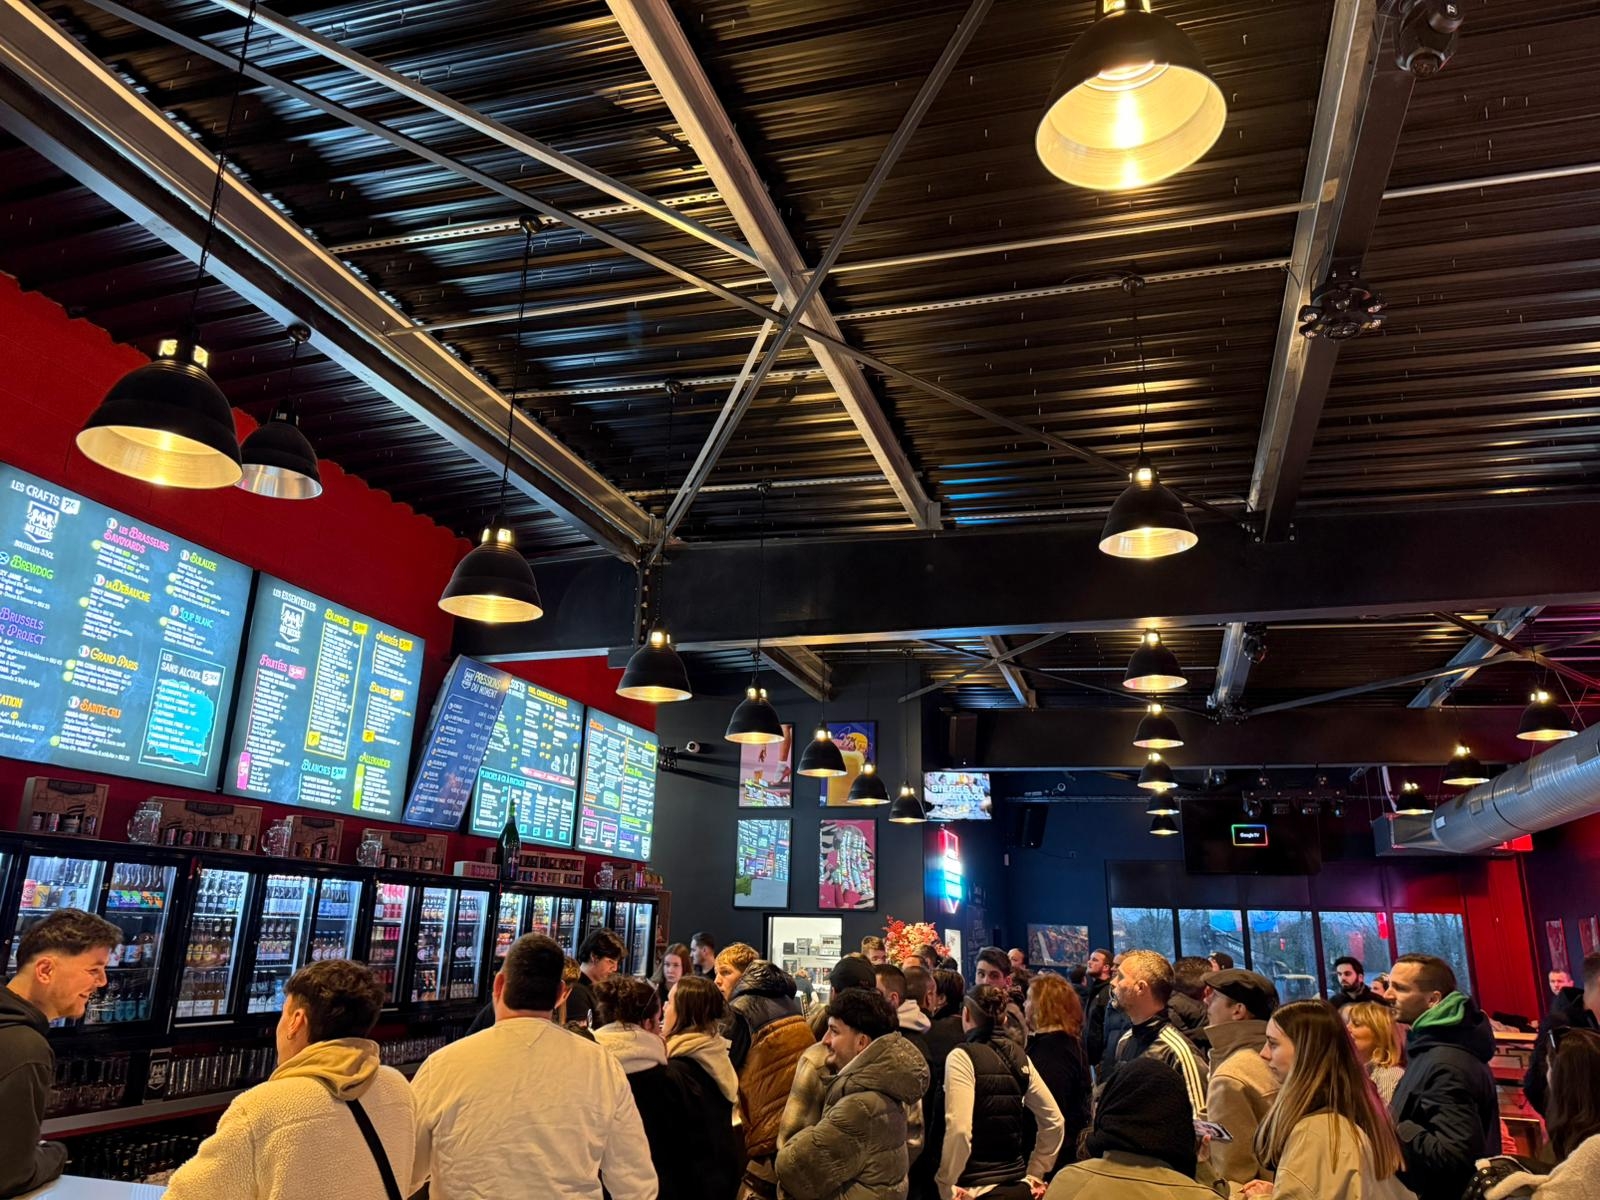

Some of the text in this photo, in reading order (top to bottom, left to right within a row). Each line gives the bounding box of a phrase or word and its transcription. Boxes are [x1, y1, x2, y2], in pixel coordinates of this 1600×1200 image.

[10, 480, 25, 493] LES
[26, 484, 61, 507] CRAFTS
[103, 529, 146, 554] SAVOYARDS
[129, 527, 170, 552] BRASSEURS
[10, 554, 54, 580] BREWDOG
[281, 590, 317, 612] ESSENTIELLES
[0, 607, 44, 630] BRUSSELS
[6, 623, 47, 645] PROJECT
[90, 647, 139, 672] GRAND PARIS
[163, 652, 173, 662] LES
[160, 661, 201, 681] SANS ALCOOL
[474, 671, 502, 690] PRESSIONS
[301, 758, 331, 776] BLANCHES
